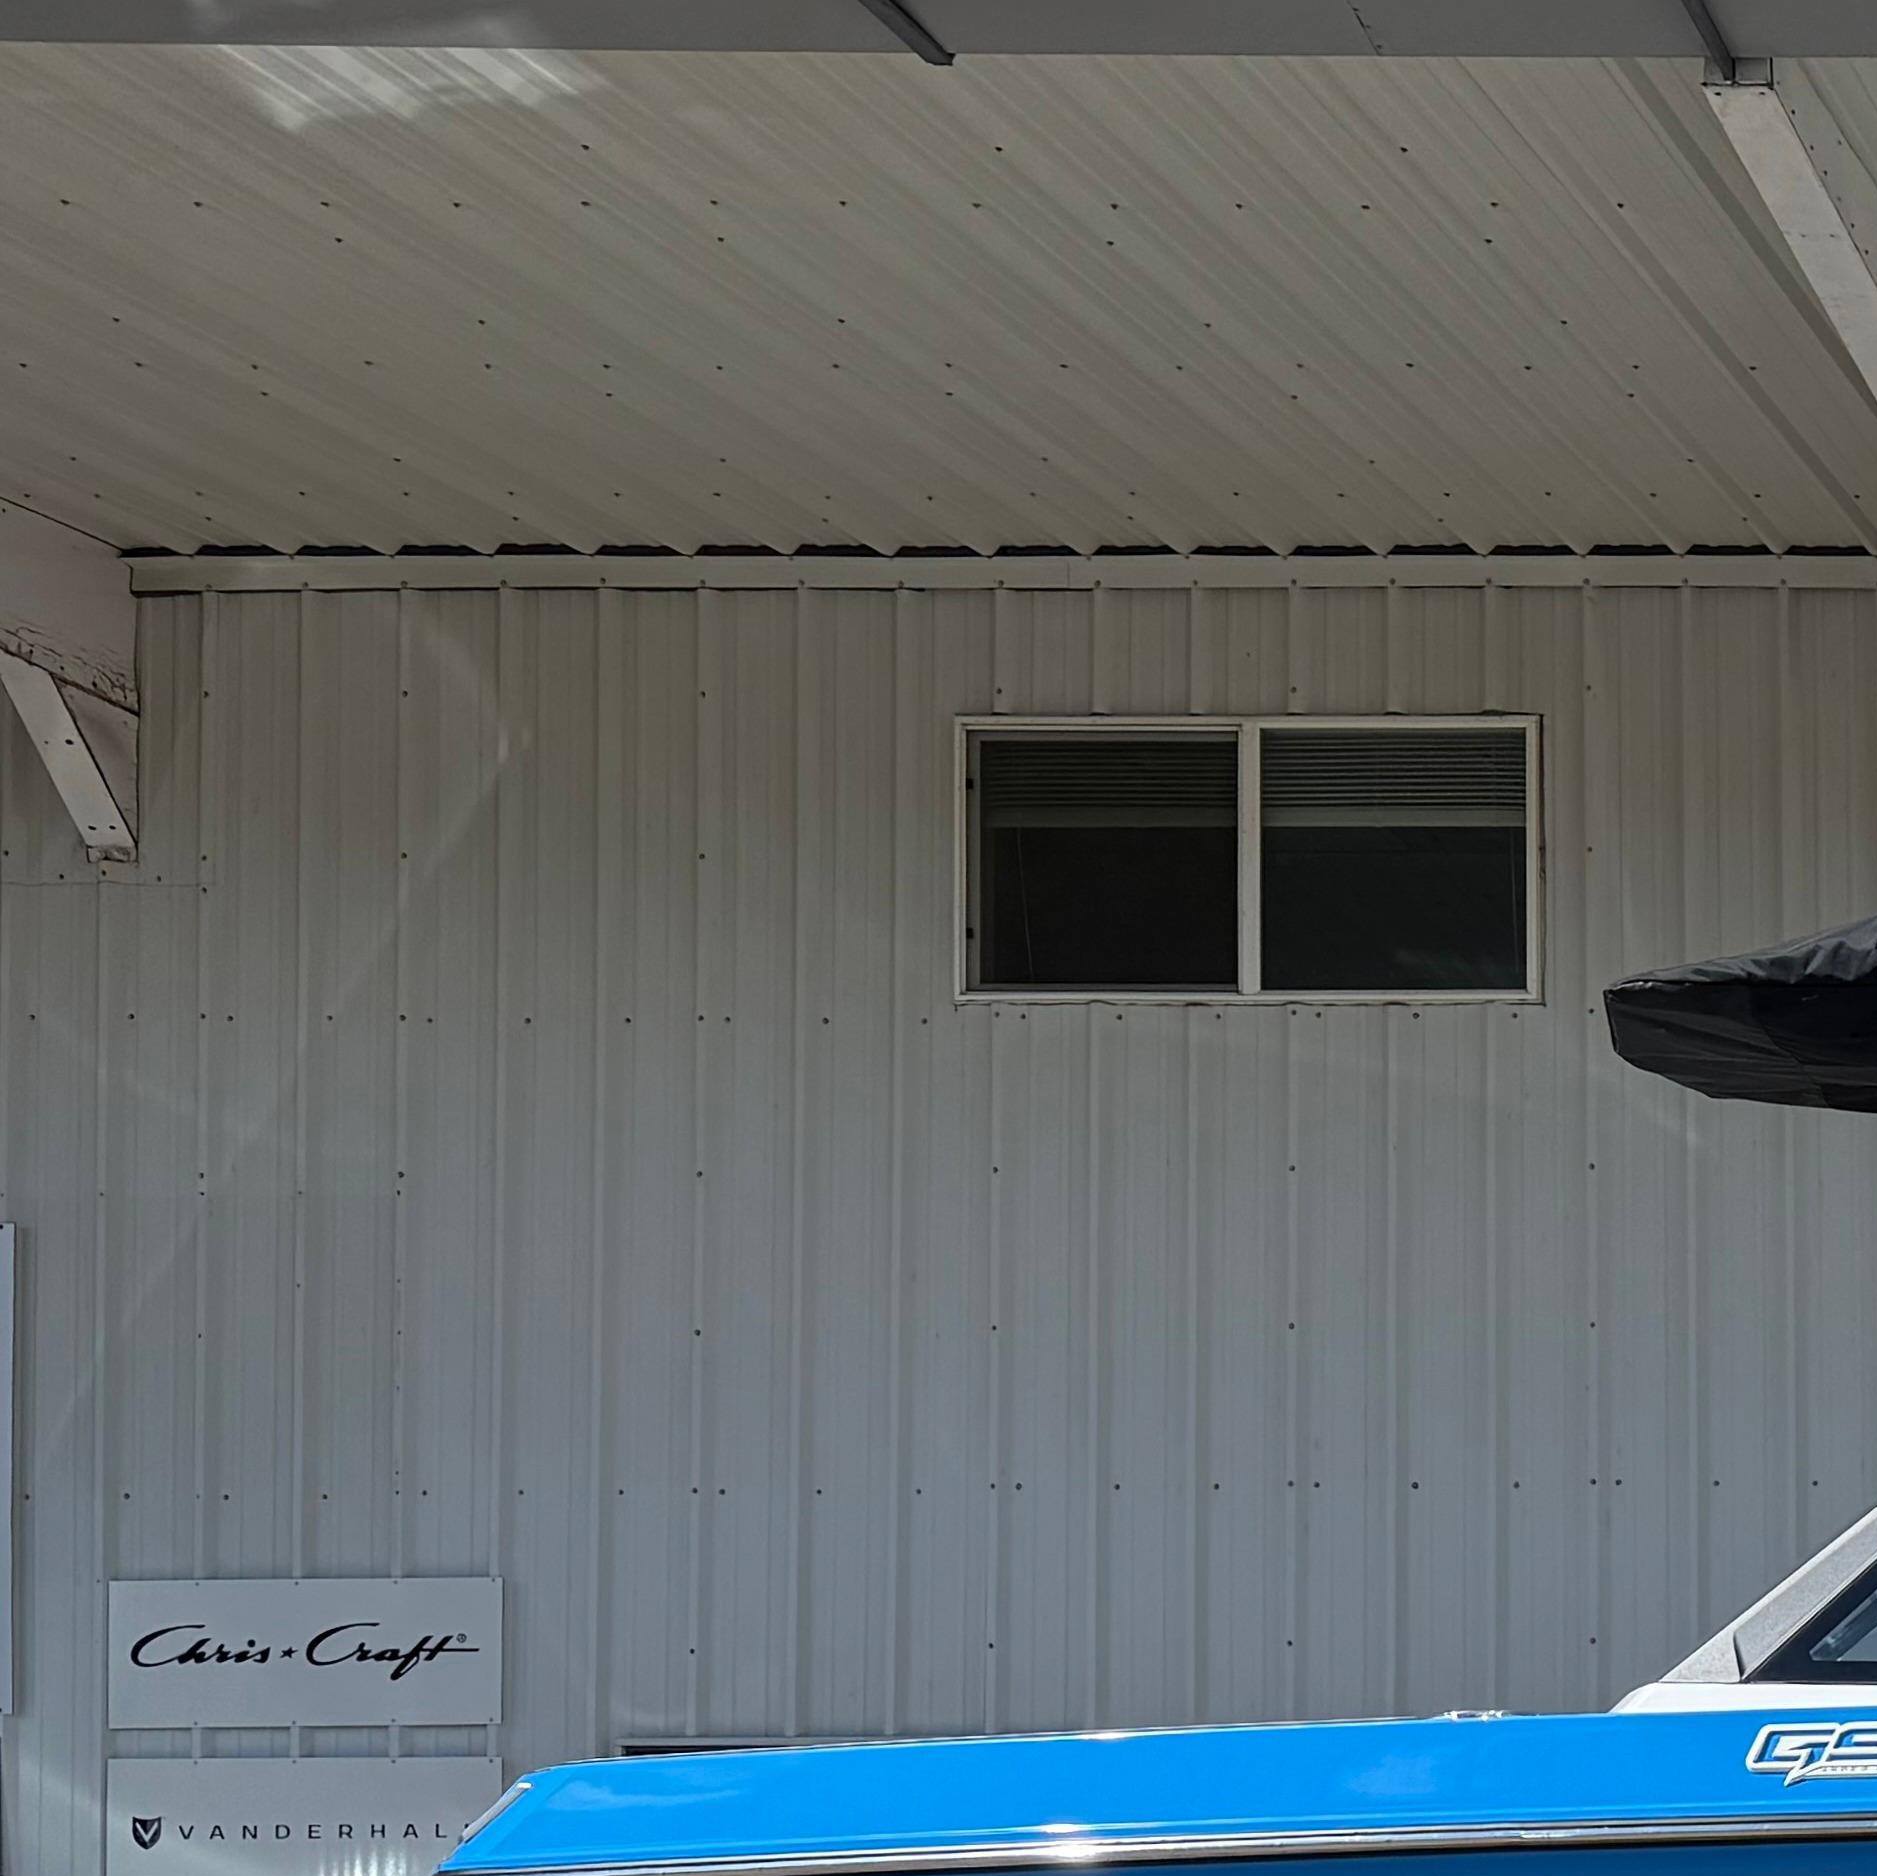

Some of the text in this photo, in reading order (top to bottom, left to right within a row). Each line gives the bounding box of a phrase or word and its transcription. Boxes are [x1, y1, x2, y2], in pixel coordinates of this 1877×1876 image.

[130, 1622, 480, 1681] Chris Craft
[178, 1823, 469, 1840] VANDERHAL
